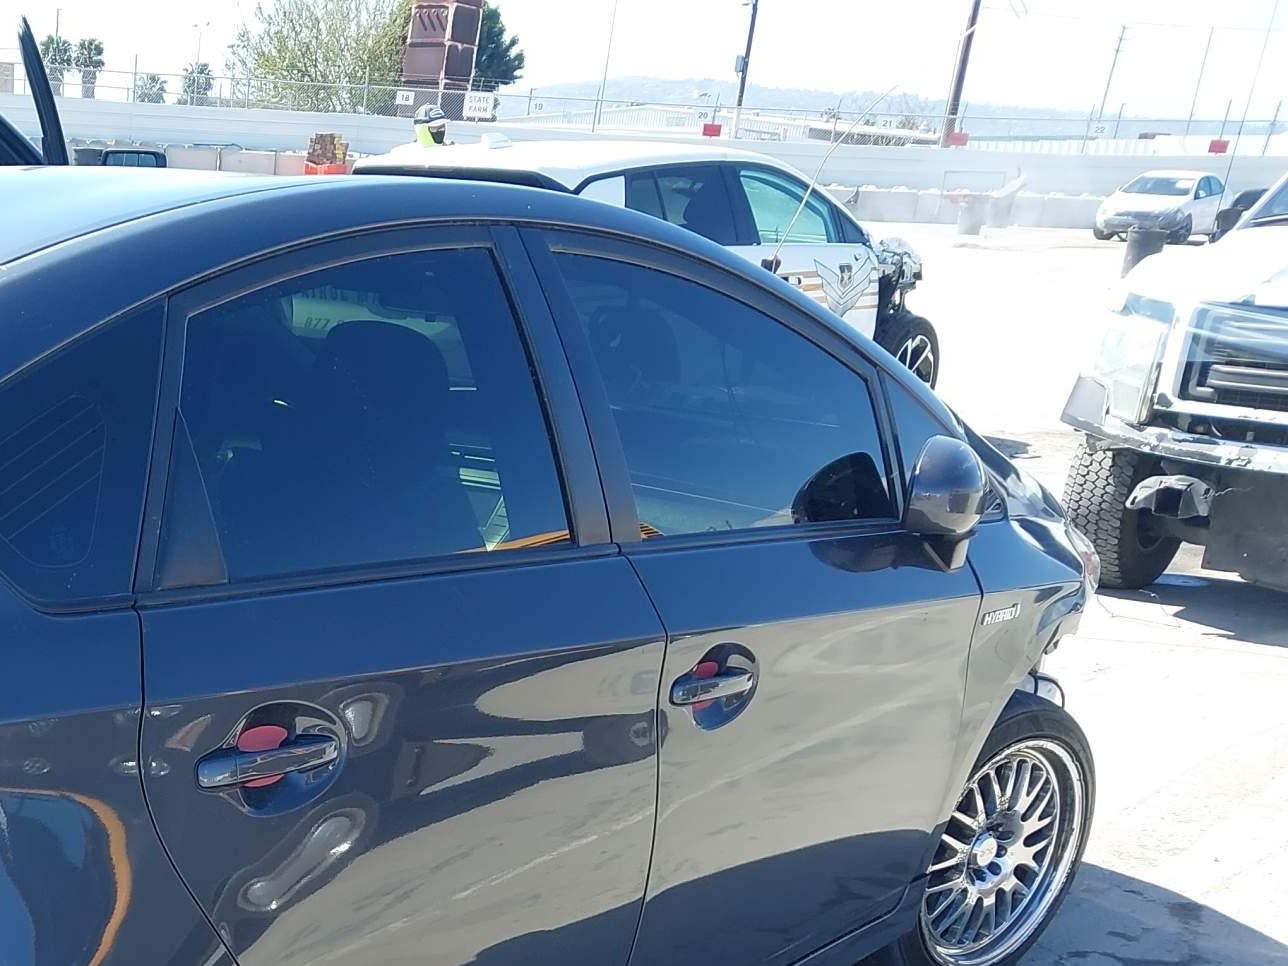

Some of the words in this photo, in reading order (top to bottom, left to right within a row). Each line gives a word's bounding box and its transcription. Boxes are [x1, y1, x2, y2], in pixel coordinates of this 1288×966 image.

[401, 94, 410, 102] 18
[468, 95, 491, 104] STATE
[468, 105, 489, 113] FARM
[533, 102, 544, 111] 19
[698, 111, 709, 120] 20
[882, 119, 894, 128] 21
[1094, 126, 1106, 134] 22
[983, 605, 1019, 626] HYBRID
